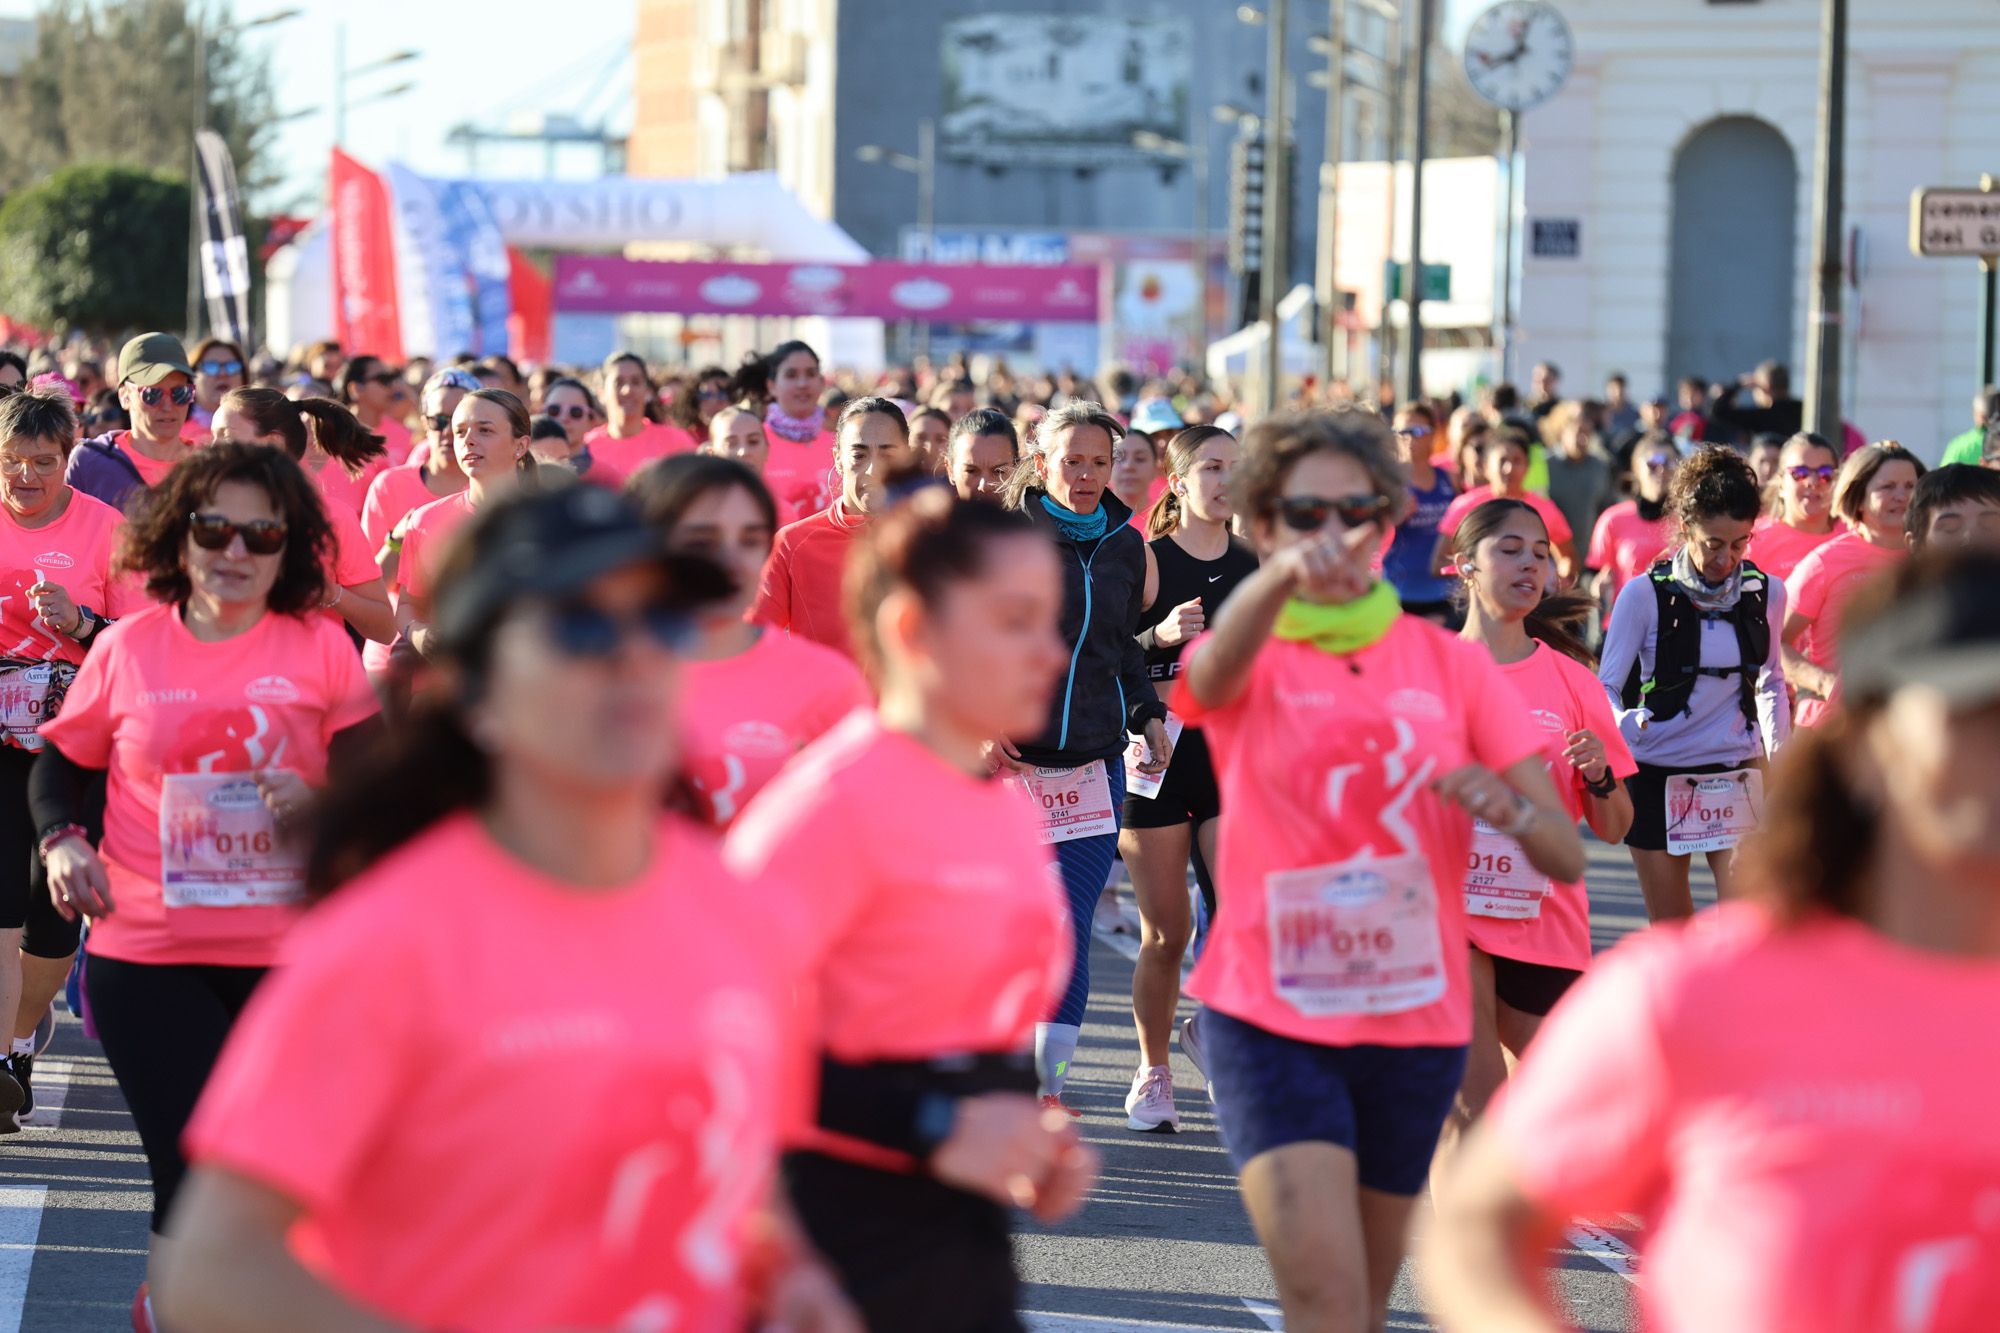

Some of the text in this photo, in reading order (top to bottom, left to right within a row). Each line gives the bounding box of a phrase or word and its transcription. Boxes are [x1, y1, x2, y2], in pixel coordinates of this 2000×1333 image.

[39, 556, 71, 566] ASTURIANA
[1041, 791, 1080, 809] 016
[1051, 810, 1069, 819] 5741
[1699, 806, 1734, 822] 016
[1074, 823, 1105, 834] Santander
[215, 831, 272, 854] 016
[1678, 842, 1708, 851] OYSHO
[1467, 852, 1513, 874] 016
[1472, 875, 1495, 886] 2127
[1495, 903, 1530, 913] Santander
[1330, 927, 1395, 958] 016
